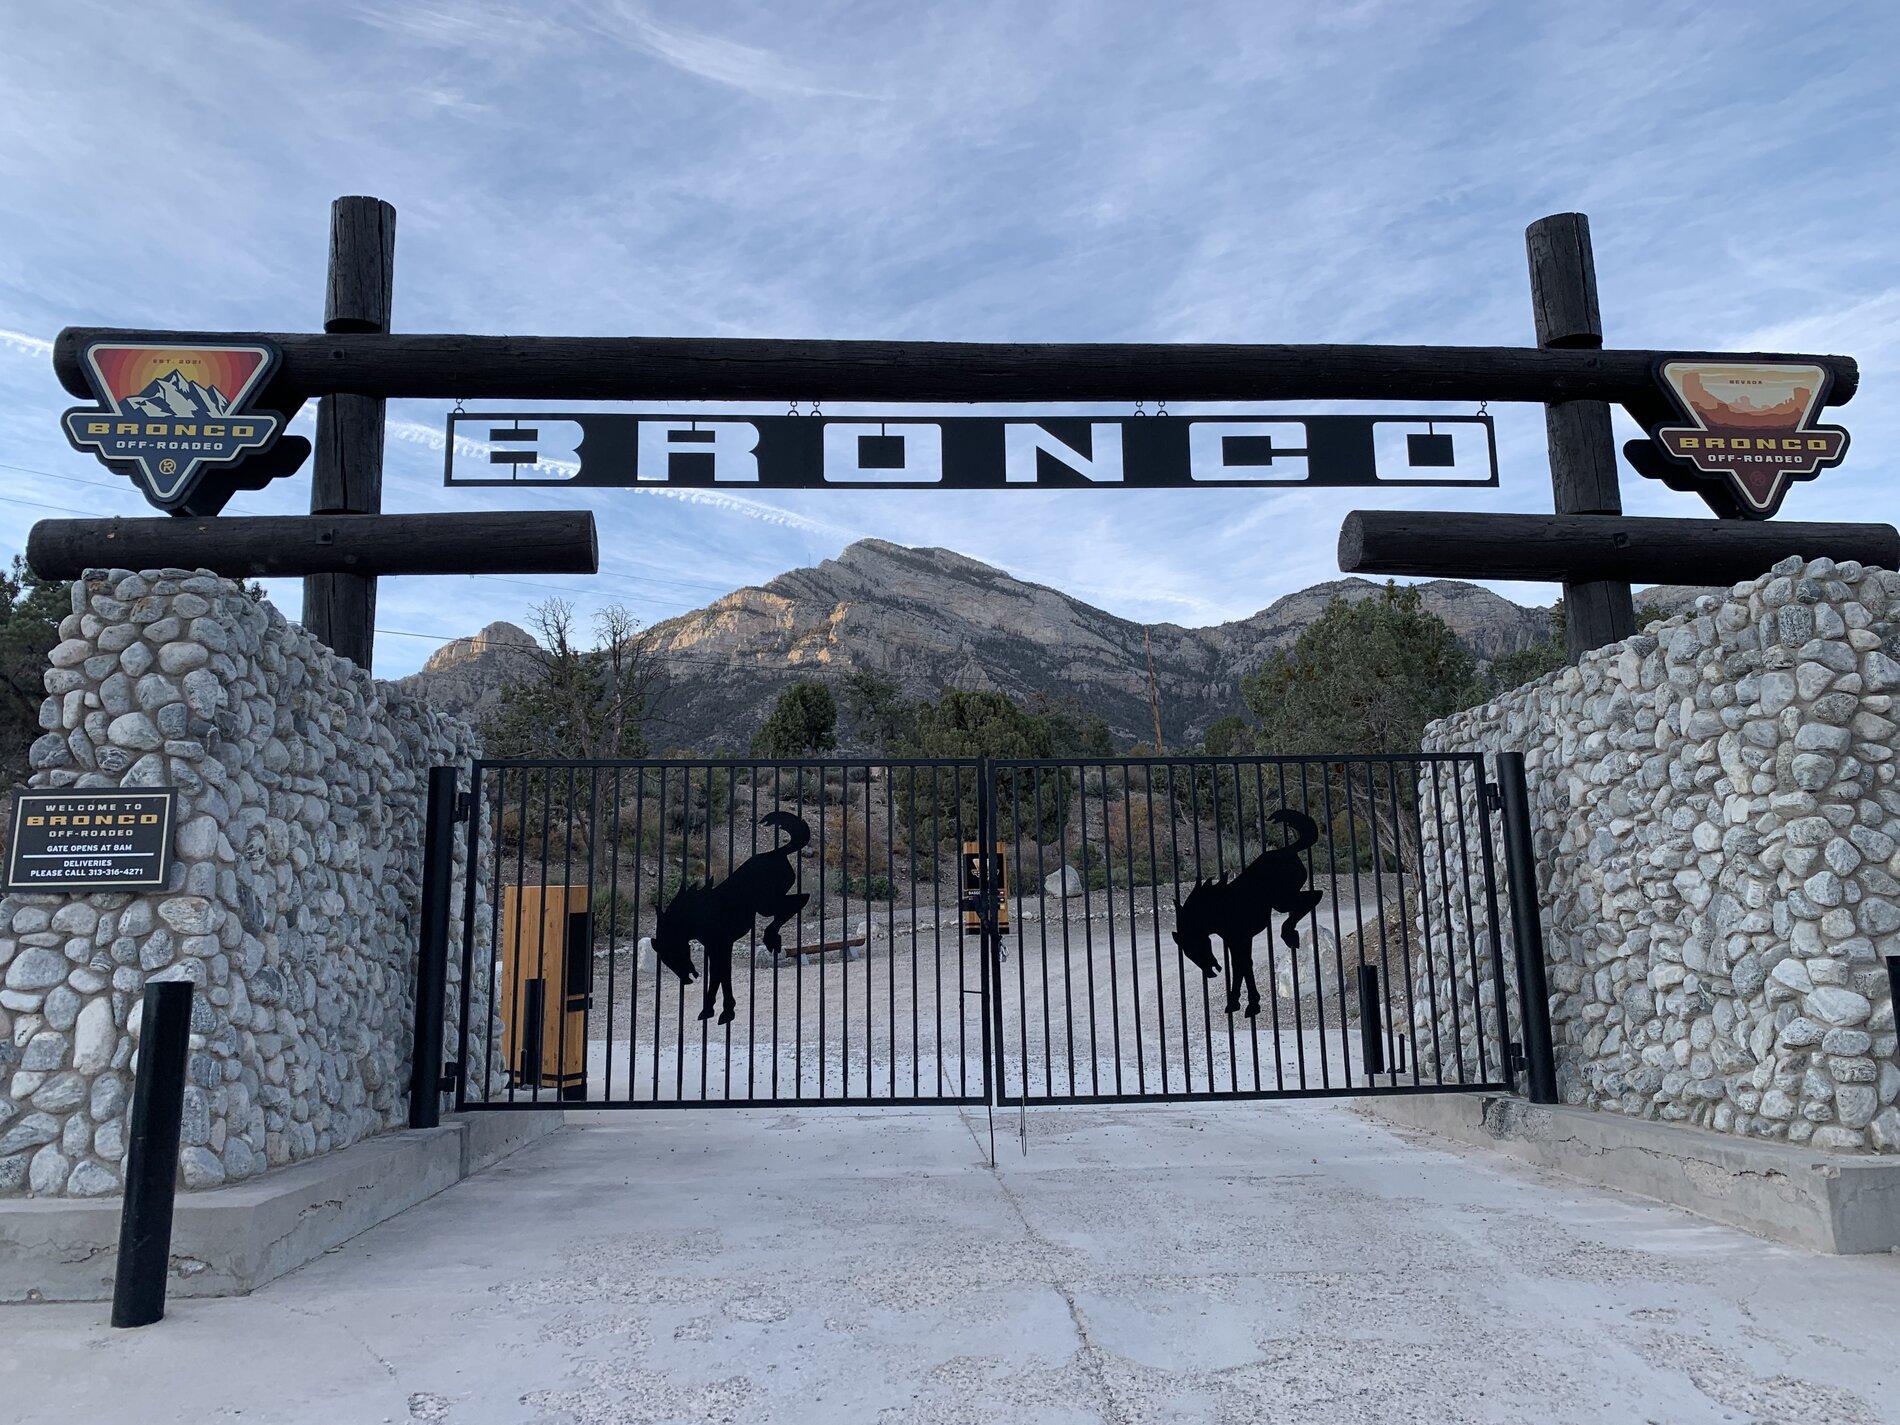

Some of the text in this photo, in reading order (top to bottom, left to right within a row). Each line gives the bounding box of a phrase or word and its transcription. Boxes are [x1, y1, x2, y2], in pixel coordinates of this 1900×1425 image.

[87, 422, 254, 437] BRONCO
[116, 440, 223, 451] OFF-ROADEO
[1679, 437, 1827, 451] BRONCO
[450, 417, 1493, 483] BRONCO
[1707, 454, 1803, 463] OFF-ROADEO
[45, 803, 117, 812] WELCOME
[26, 814, 158, 826] BRONCO
[48, 829, 134, 838] OFF-ROADEO
[70, 844, 99, 852] OPENS
[63, 859, 112, 867] DELIVERIES
[30, 869, 63, 877] PLEASE
[88, 868, 144, 876] 313-316-4271
